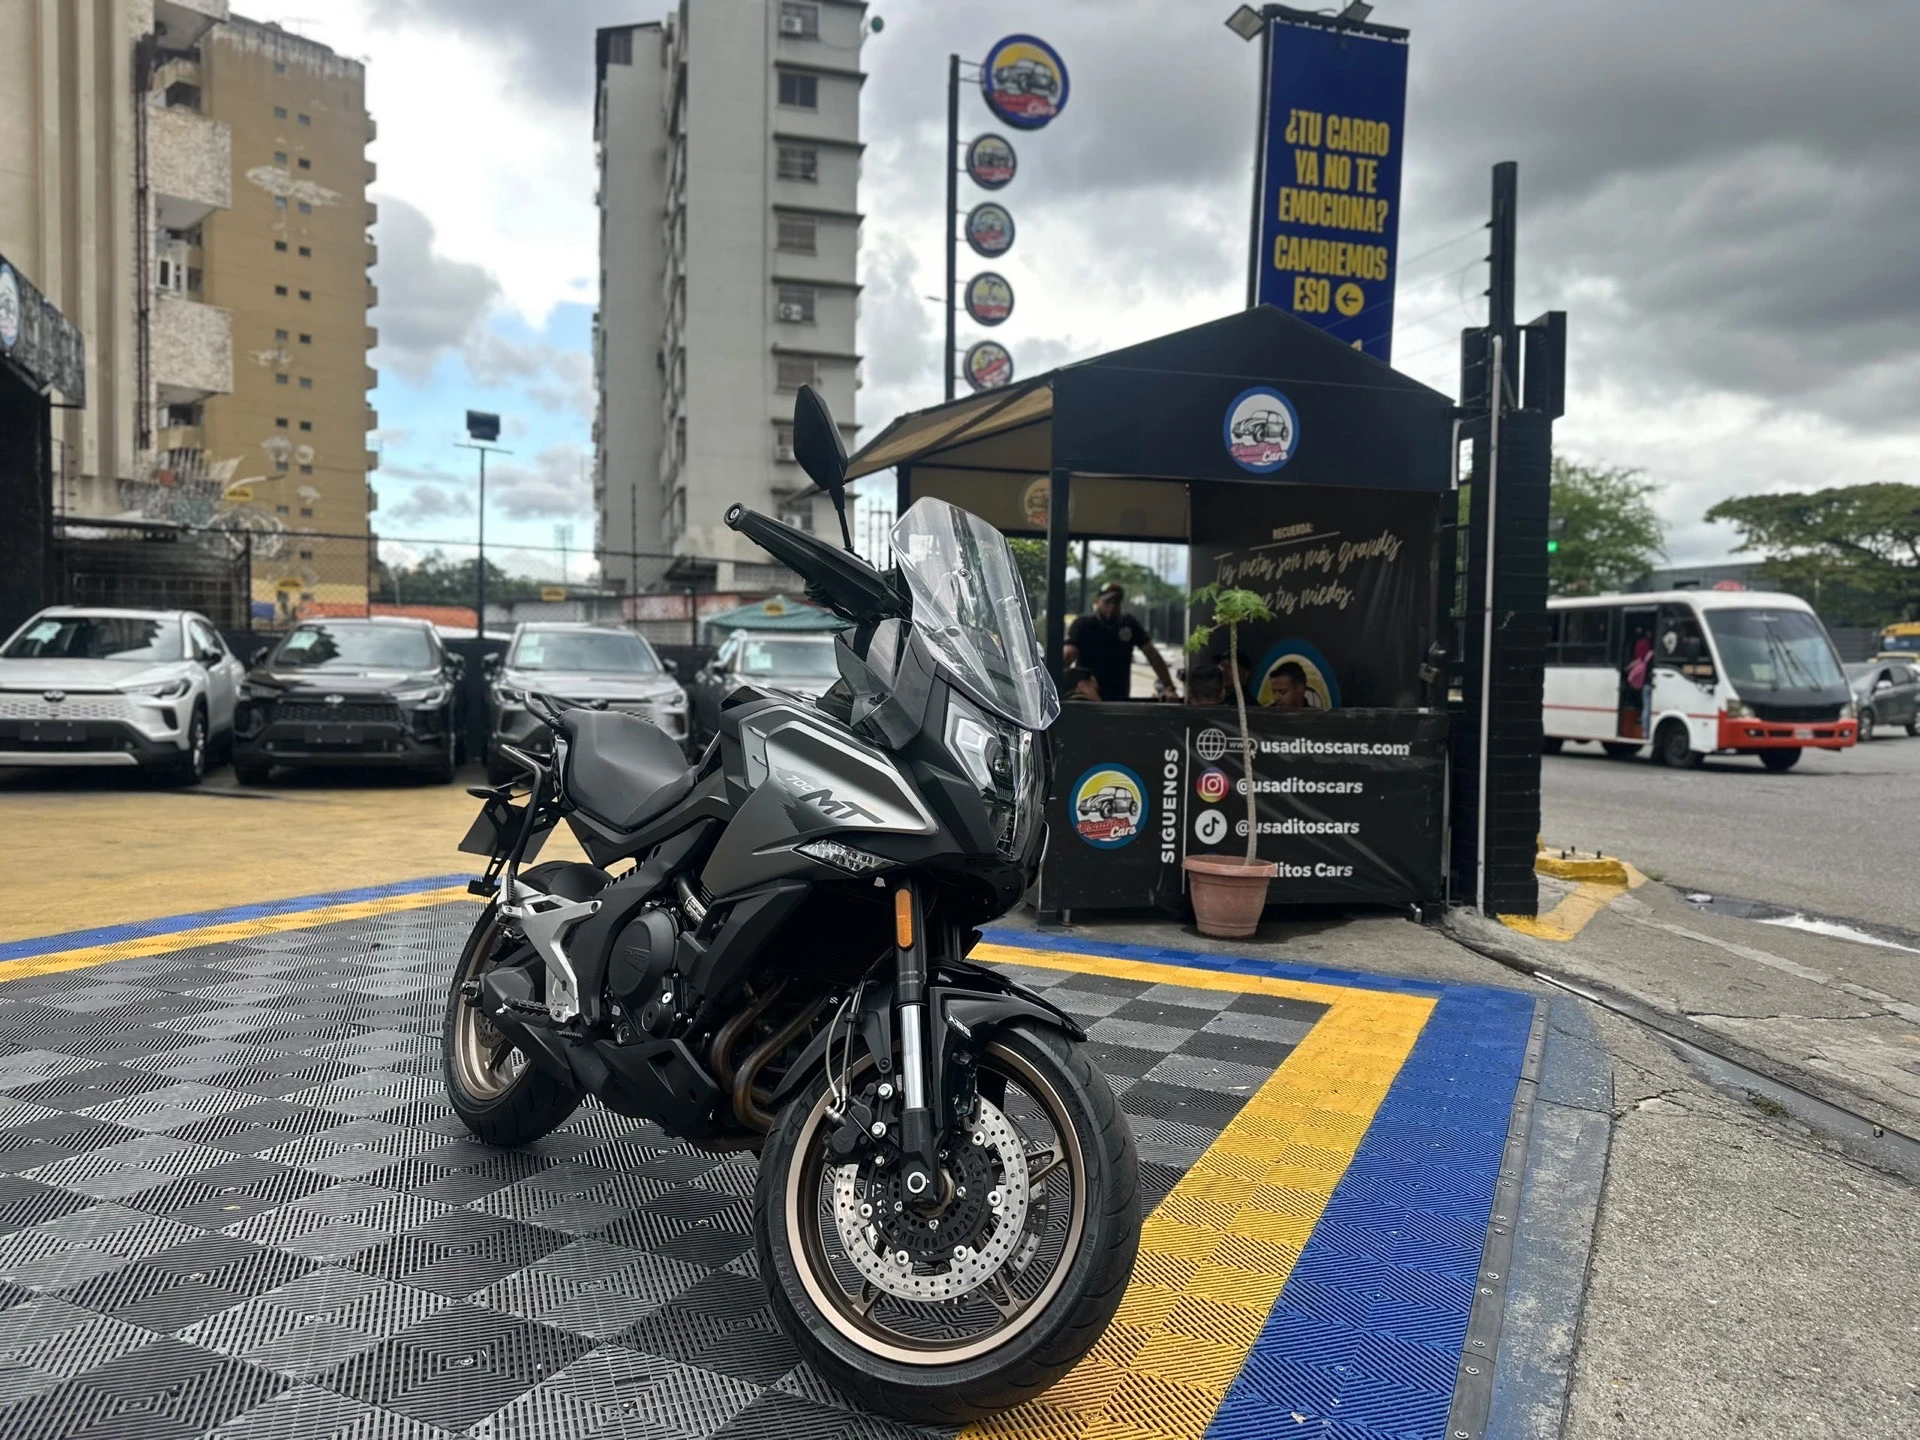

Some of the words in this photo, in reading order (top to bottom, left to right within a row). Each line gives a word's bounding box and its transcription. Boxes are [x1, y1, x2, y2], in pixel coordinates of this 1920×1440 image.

[1285, 109, 1322, 147] ¿TU
[1326, 114, 1390, 157] CARRO
[1295, 149, 1319, 186] YA
[1324, 152, 1351, 190] NO
[1356, 158, 1379, 194] TE
[1278, 187, 1389, 233] EMOCIONA?
[1273, 235, 1388, 281] CAMBIEMOS
[1293, 276, 1331, 314] ESO
[1238, 551, 1277, 582] metas
[1276, 553, 1304, 580] son
[1275, 585, 1299, 615] tus
[1299, 578, 1356, 611] miedos.
[1260, 737, 1411, 756] usaditoscars.com
[785, 775, 817, 792] 700
[1236, 776, 1364, 795] @usaditoscars
[798, 788, 885, 825] MT
[1161, 749, 1179, 864] SIGUENOS
[1110, 824, 1137, 838] Cars
[1271, 862, 1312, 878] itos
[1314, 862, 1354, 878] Cars
